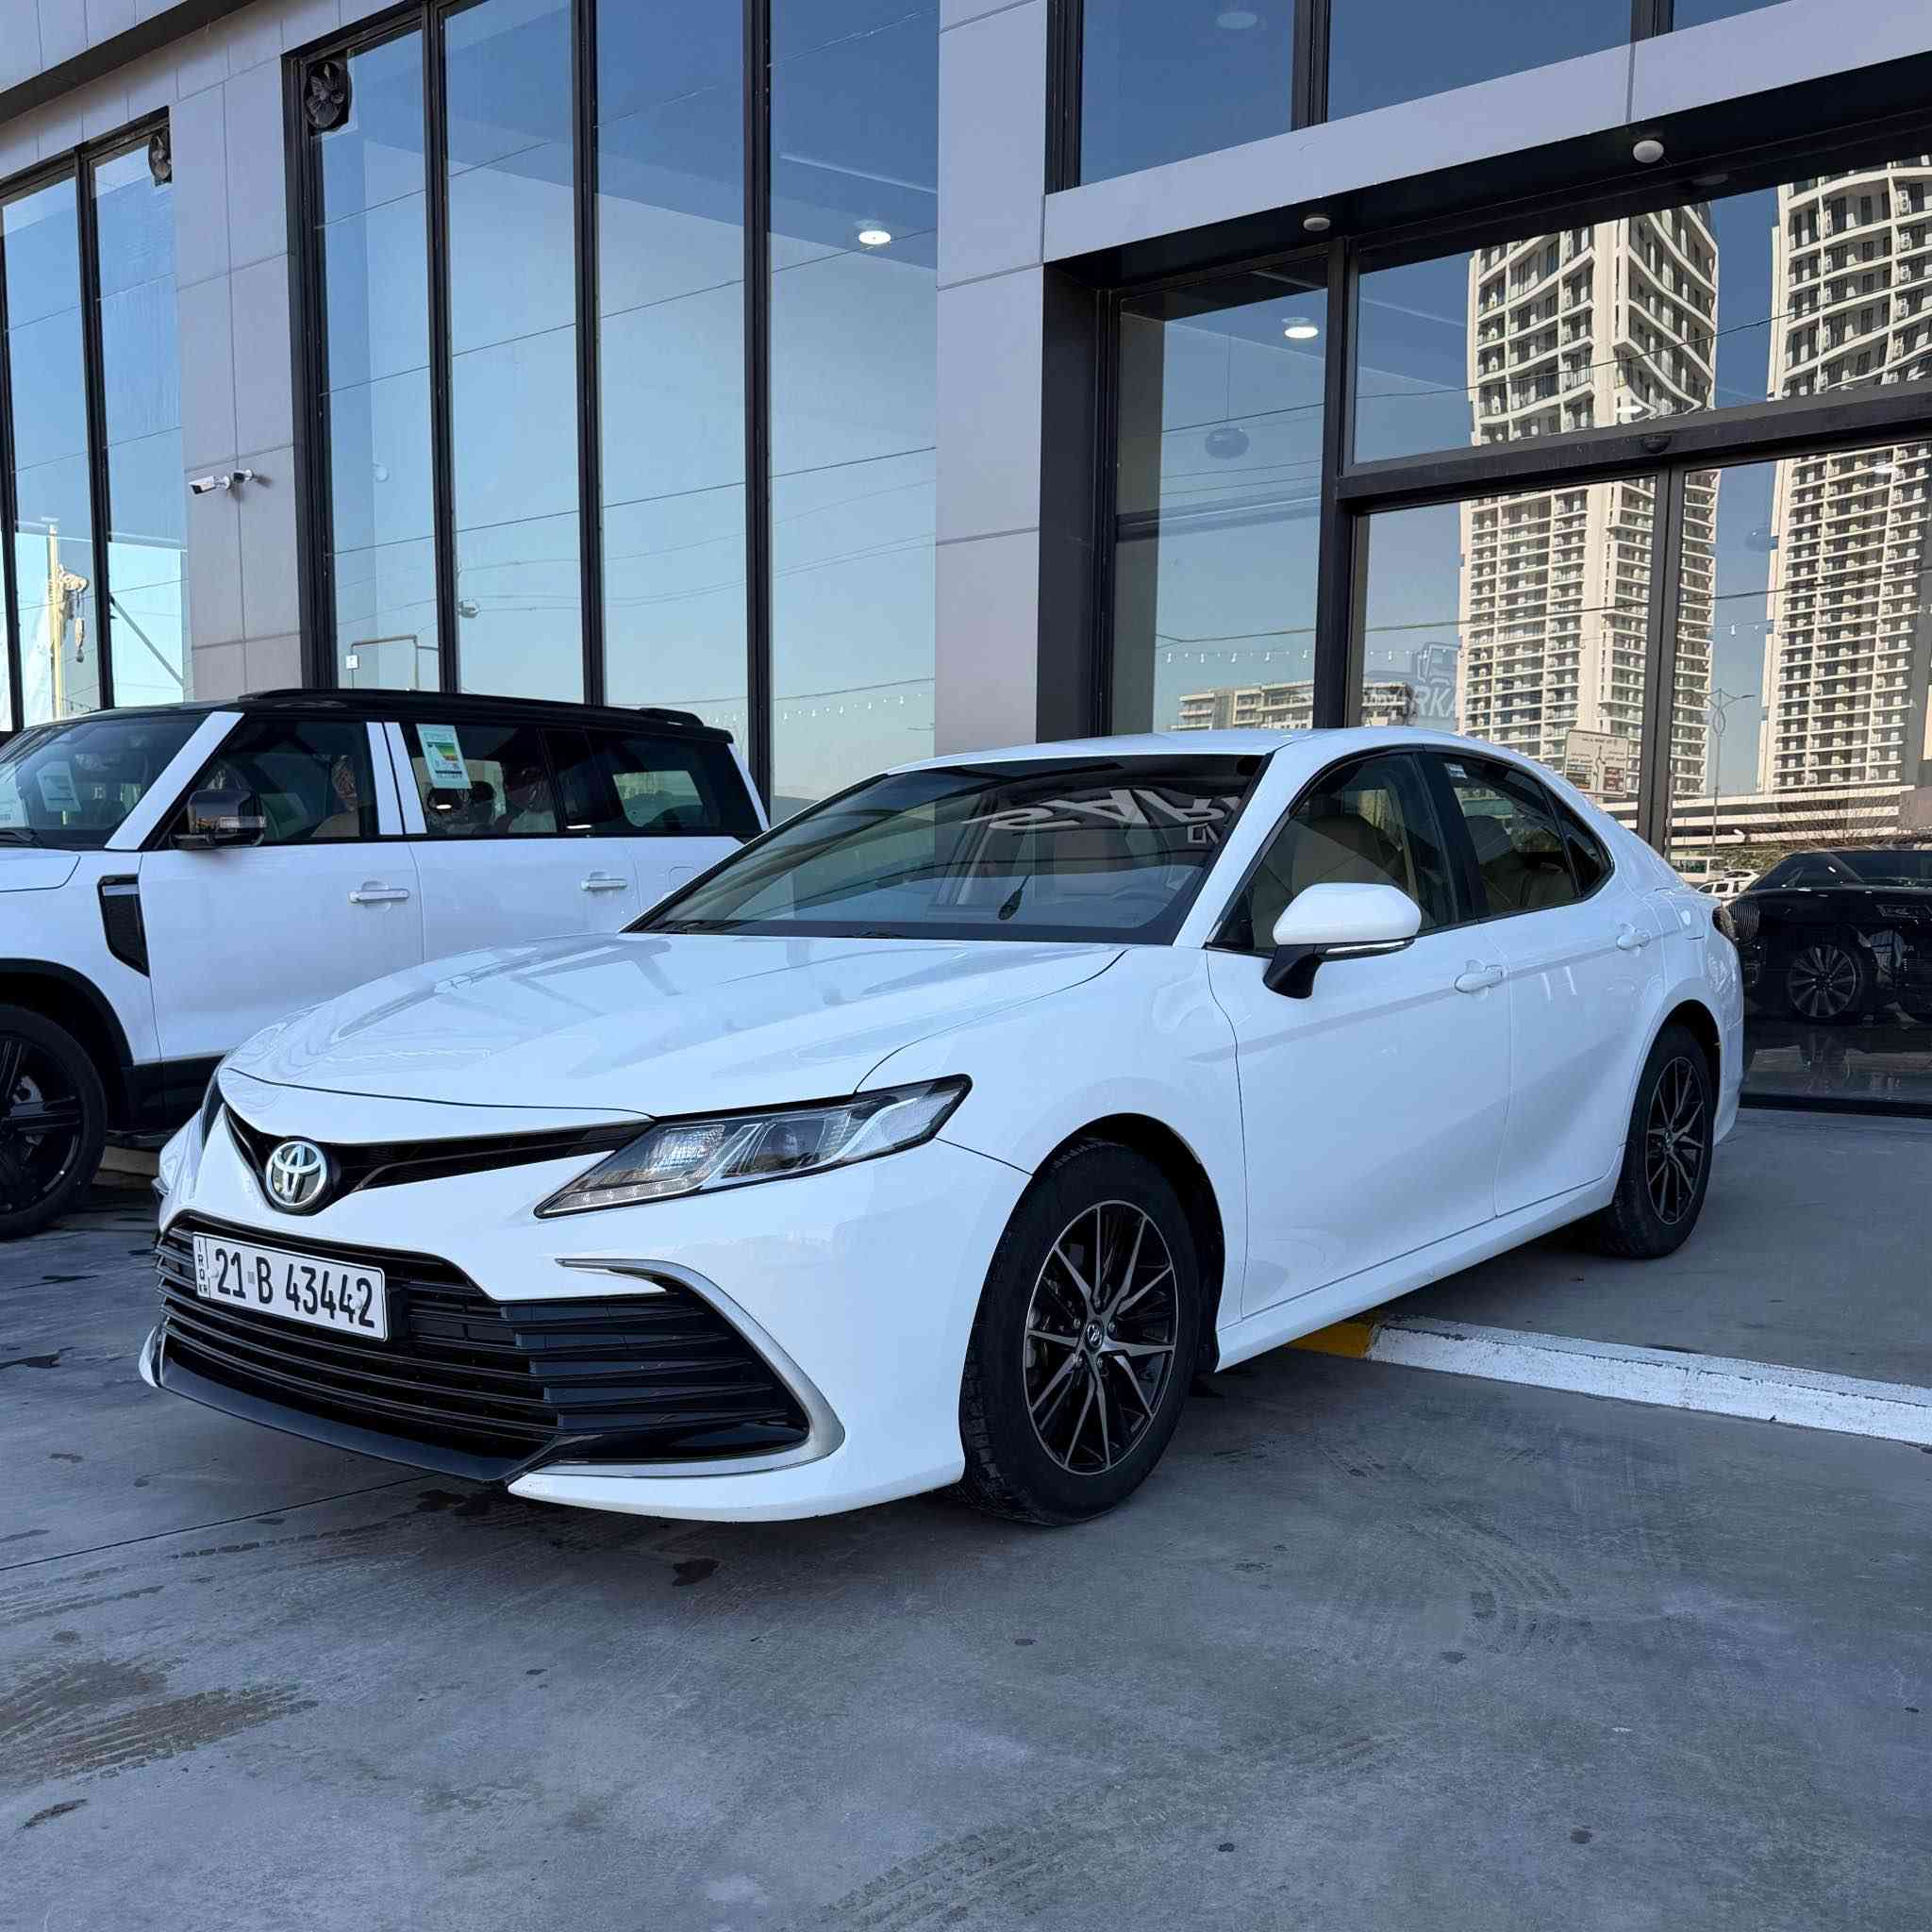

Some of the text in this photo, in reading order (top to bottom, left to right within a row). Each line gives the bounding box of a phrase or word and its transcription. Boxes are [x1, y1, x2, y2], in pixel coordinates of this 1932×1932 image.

[215, 1248, 375, 1328] 21 B 43442
